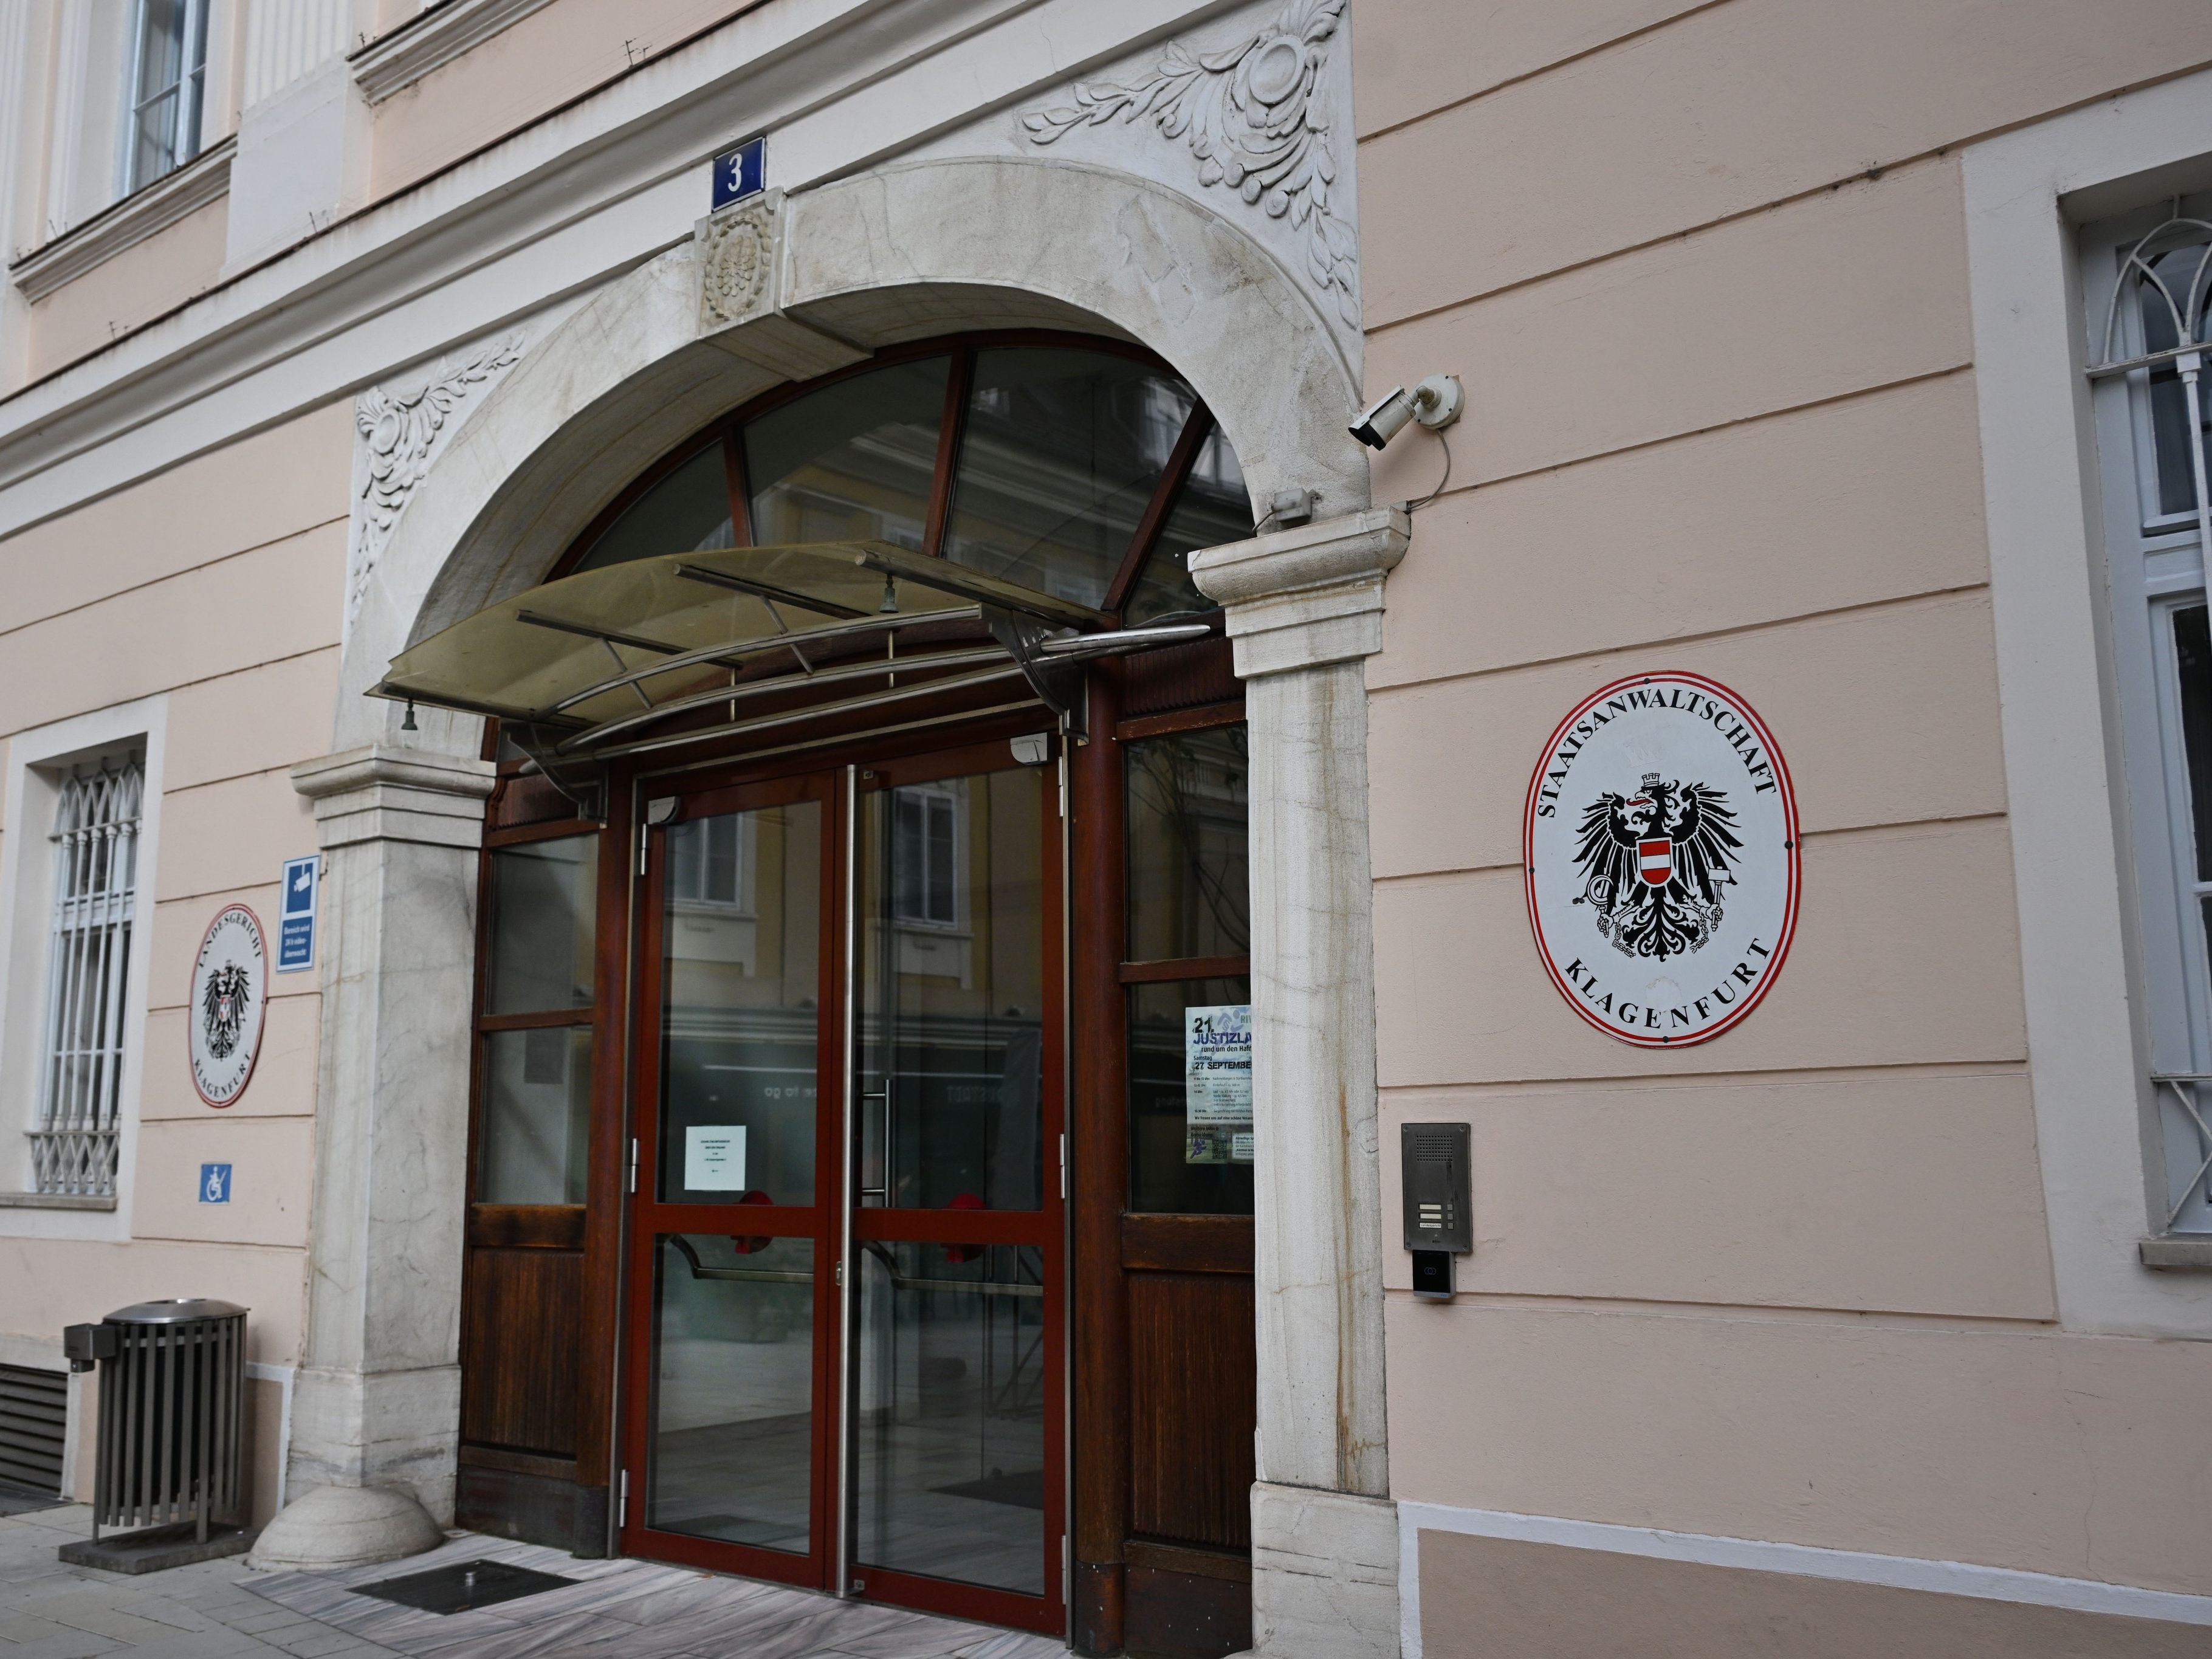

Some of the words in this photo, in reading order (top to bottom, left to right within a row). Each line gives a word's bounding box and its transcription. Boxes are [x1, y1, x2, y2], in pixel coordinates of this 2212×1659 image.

[728, 153, 742, 192] 3
[1537, 689, 1777, 818] STAATSANWALTSCHAFT
[199, 912, 261, 967] LANDESGERICHT
[1564, 938, 1771, 1029] KLAGENFURT
[194, 1050, 250, 1098] KLAGENFURT
